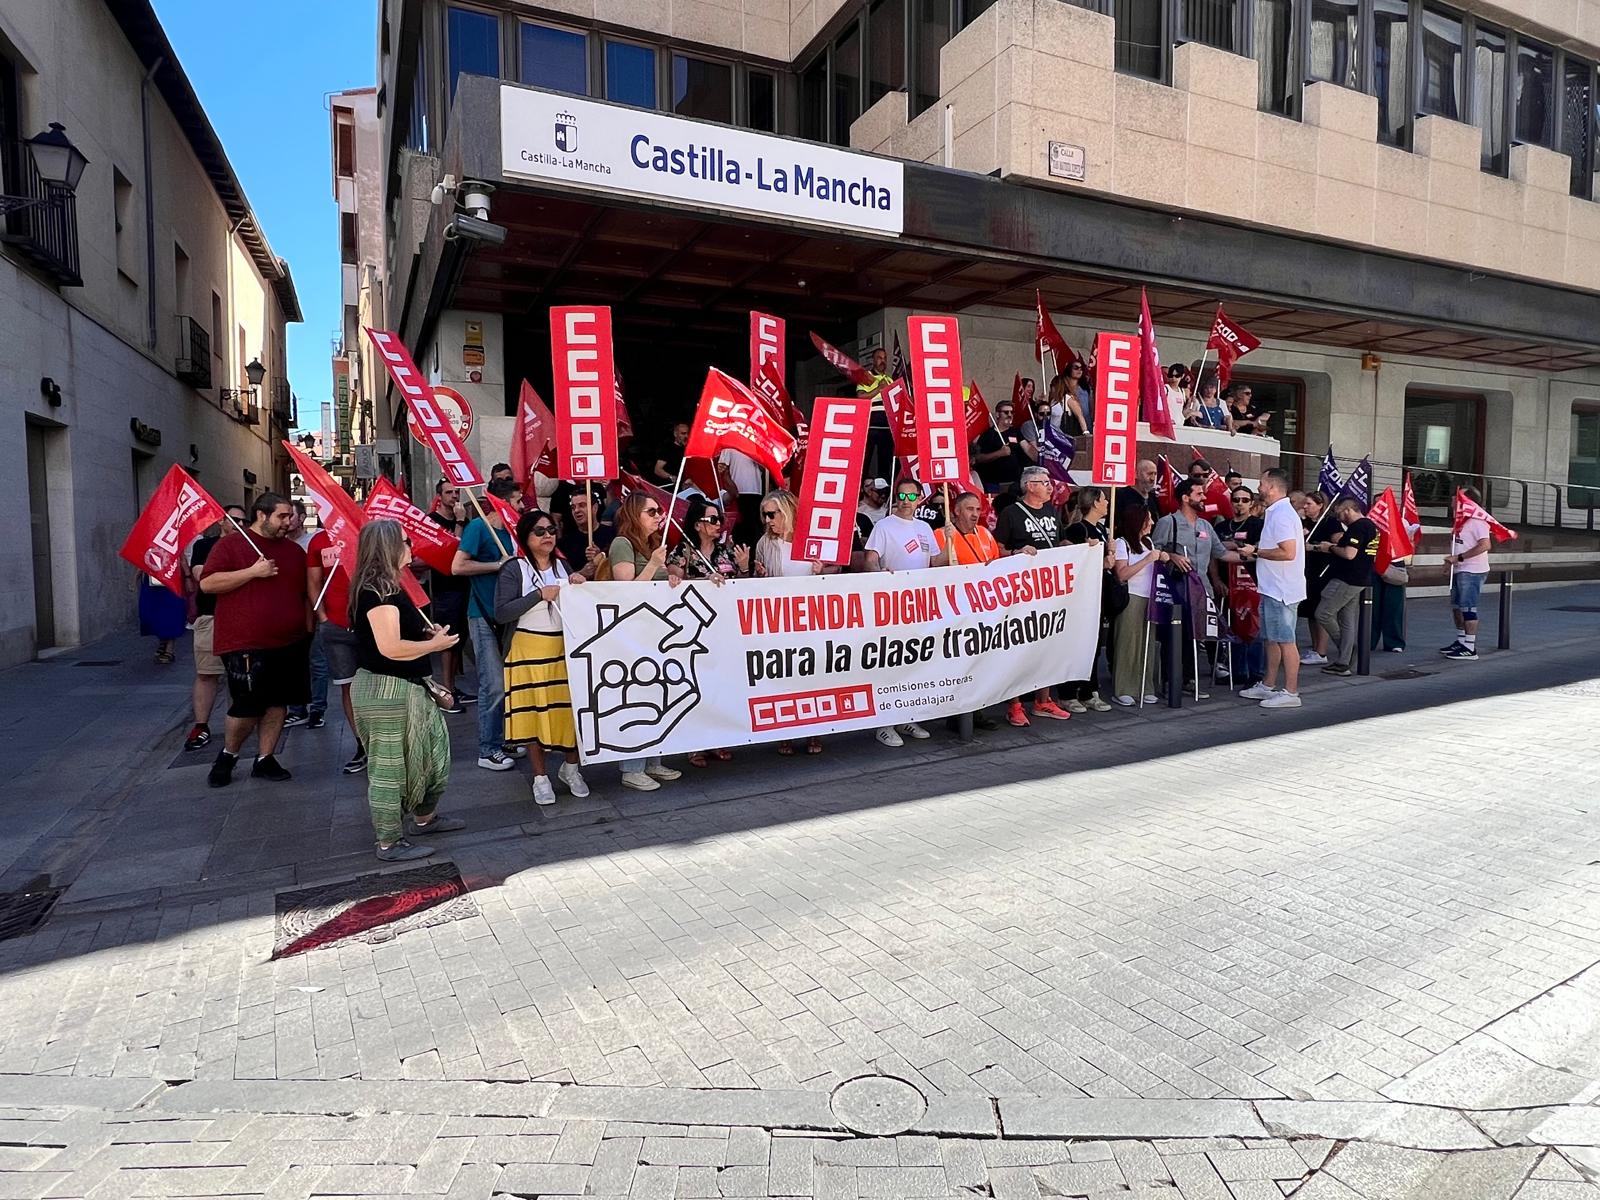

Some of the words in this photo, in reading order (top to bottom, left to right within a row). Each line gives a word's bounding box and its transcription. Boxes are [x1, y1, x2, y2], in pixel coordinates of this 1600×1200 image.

[795, 166, 891, 210] Mancha
[565, 312, 603, 455] CCOO
[921, 323, 956, 458] CCOO
[1105, 340, 1130, 463] CCOO
[809, 404, 857, 538] CCOO
[737, 593, 864, 635] VIVIENDA
[873, 586, 943, 627] DIGNA
[944, 584, 961, 615] Y
[963, 563, 1075, 613] ACCESIBLE
[746, 646, 815, 686] para
[825, 640, 851, 673] la
[860, 634, 935, 671] clase
[943, 608, 1067, 659] trabajadora
[752, 695, 838, 726] CCOO
[877, 679, 936, 695] comisiones
[938, 674, 973, 687] obreras
[879, 701, 892, 711] de
[894, 693, 955, 710] Guadalajara
